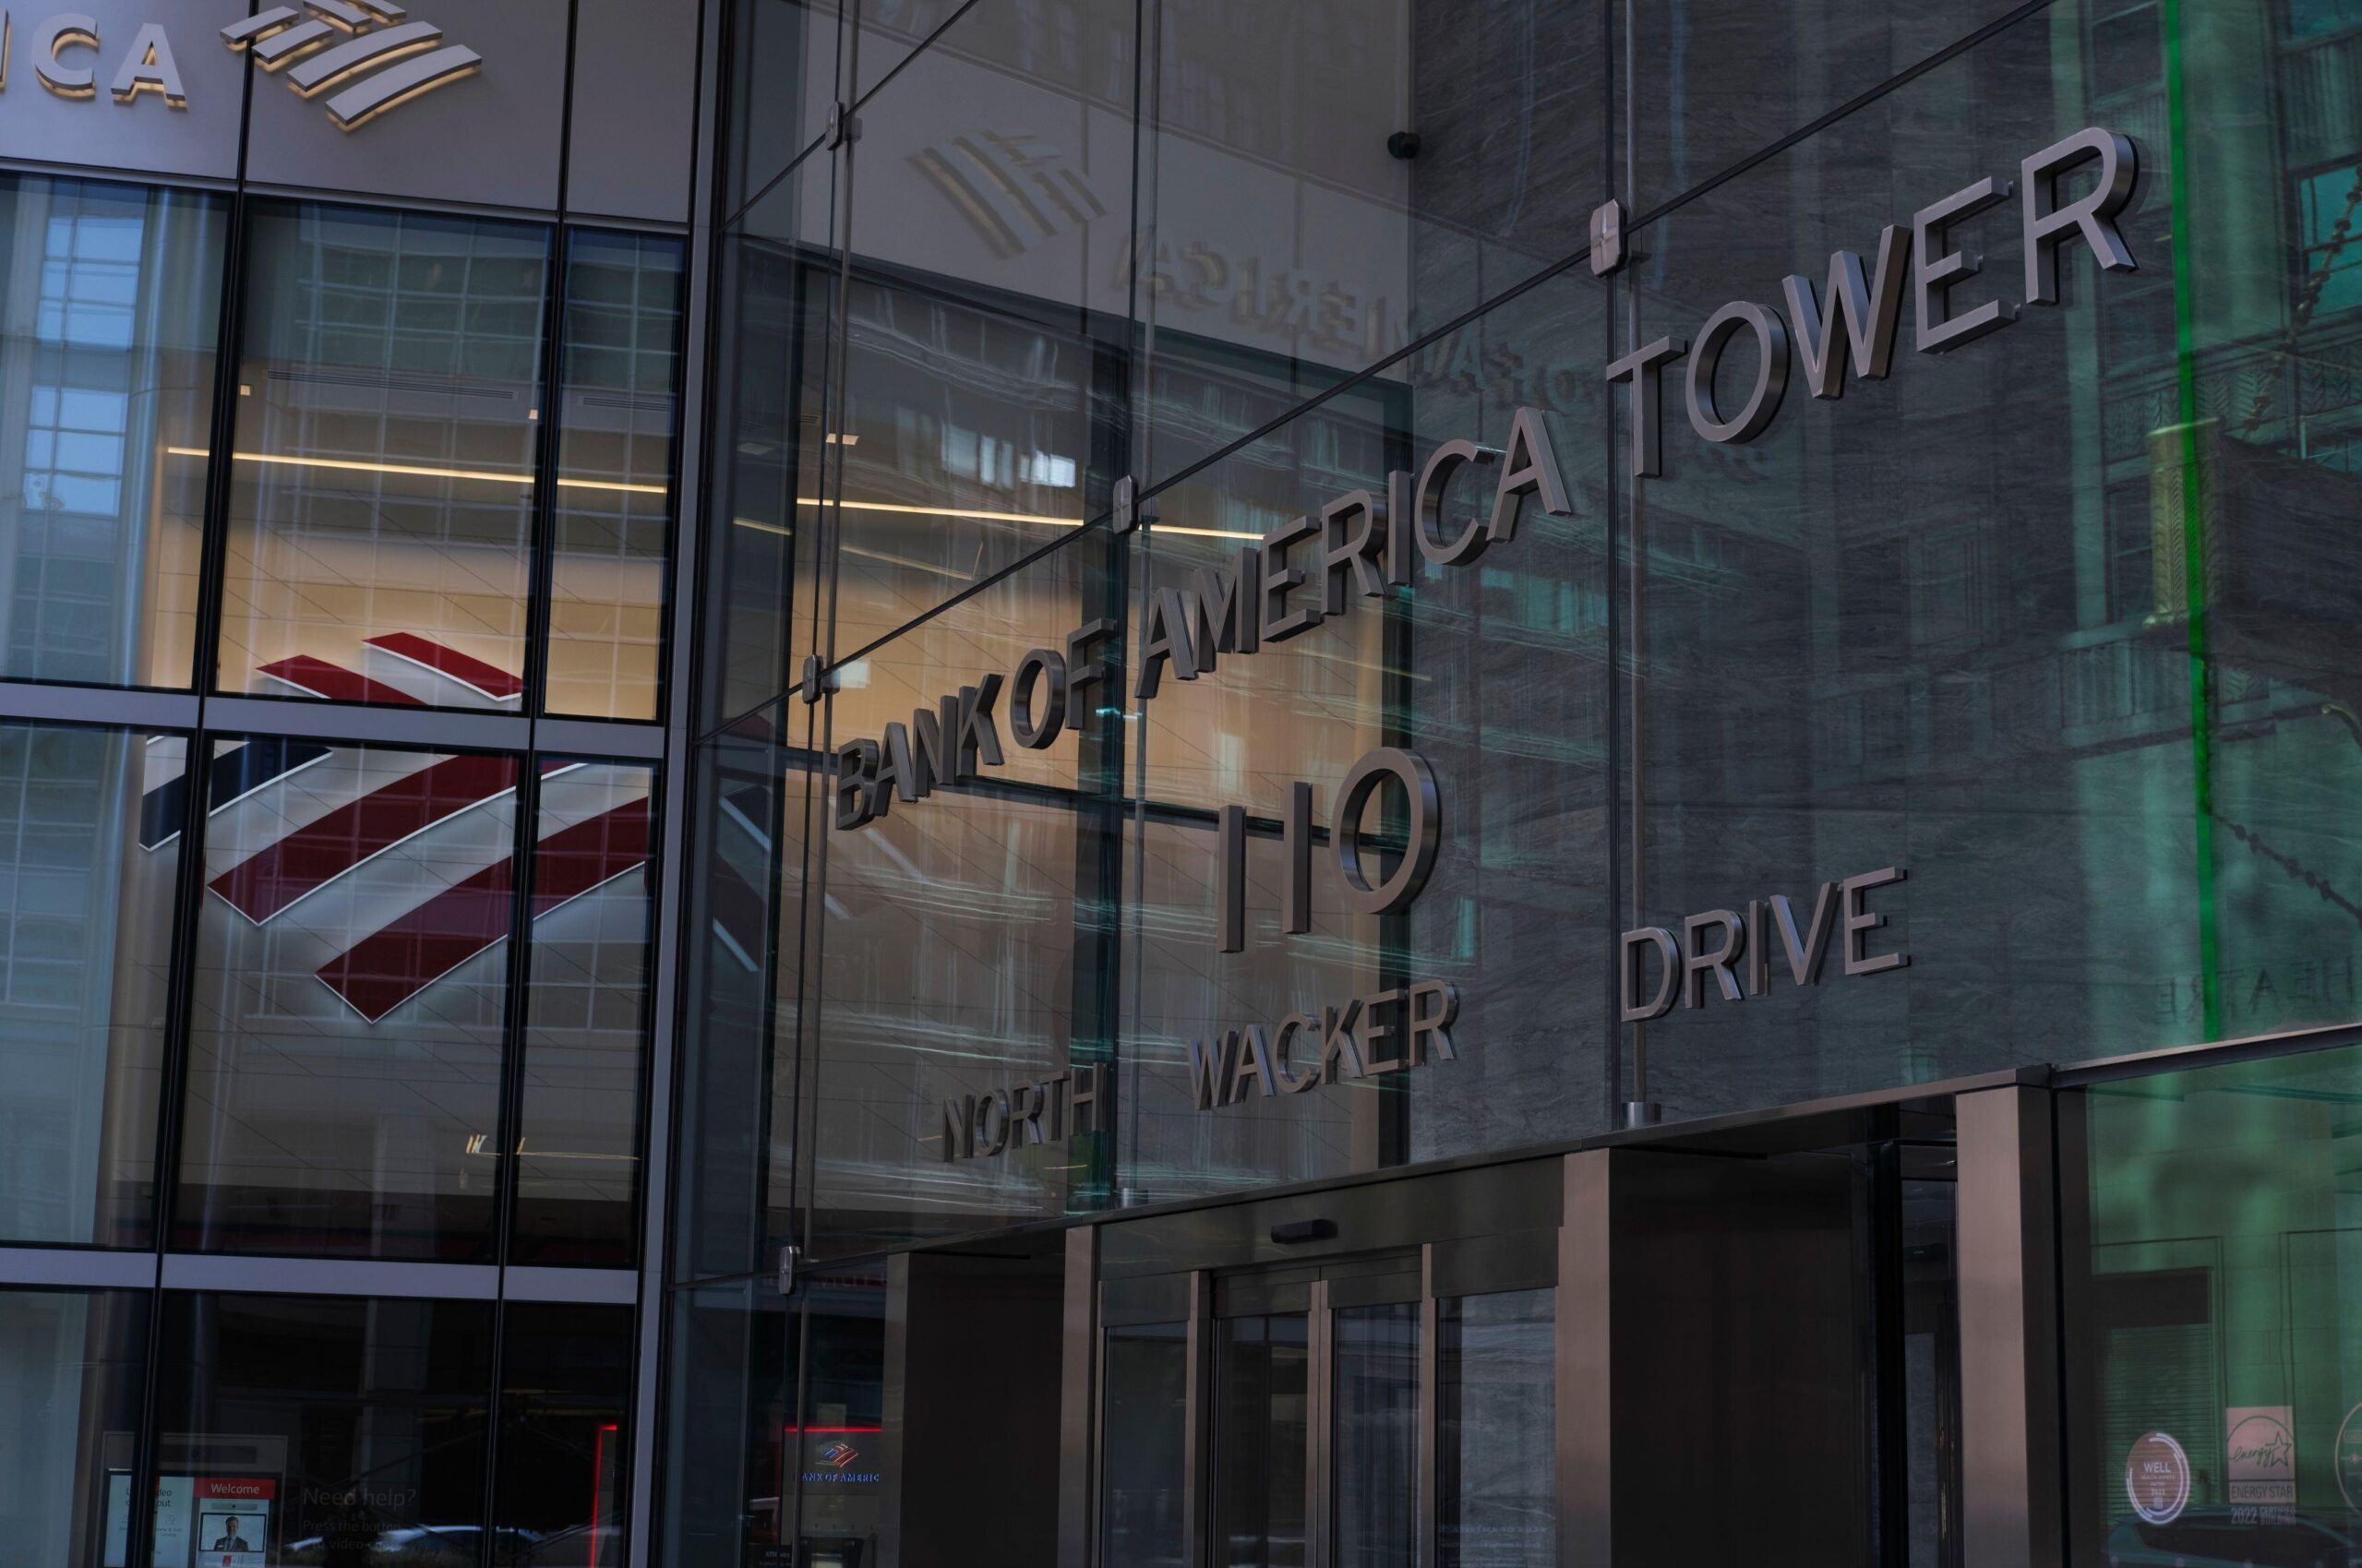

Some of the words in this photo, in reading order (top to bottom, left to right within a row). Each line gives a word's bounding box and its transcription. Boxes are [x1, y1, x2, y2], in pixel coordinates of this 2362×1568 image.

[0, 9, 188, 111] CA
[836, 674, 1004, 831] BANK
[1010, 617, 1117, 749] OF
[1135, 406, 1572, 699] AMERICA
[1606, 126, 2140, 478] TOWER
[1217, 746, 1442, 953] 110
[941, 1061, 1109, 1163] NORTH
[1187, 978, 1461, 1110] WACKER
[1621, 866, 1912, 1022] DRIVE
[2143, 1461, 2171, 1473] WELL
[803, 1472, 823, 1482] ANK
[825, 1472, 838, 1482] OF
[210, 1482, 259, 1495] Welcome
[2231, 1486, 2266, 1499] ENERGY
[2269, 1485, 2293, 1499] STAR
[303, 1487, 357, 1506] Need
[363, 1487, 417, 1512] help?
[2231, 1506, 2258, 1525] 2022
[303, 1520, 337, 1532] Press
[339, 1520, 358, 1532] the
